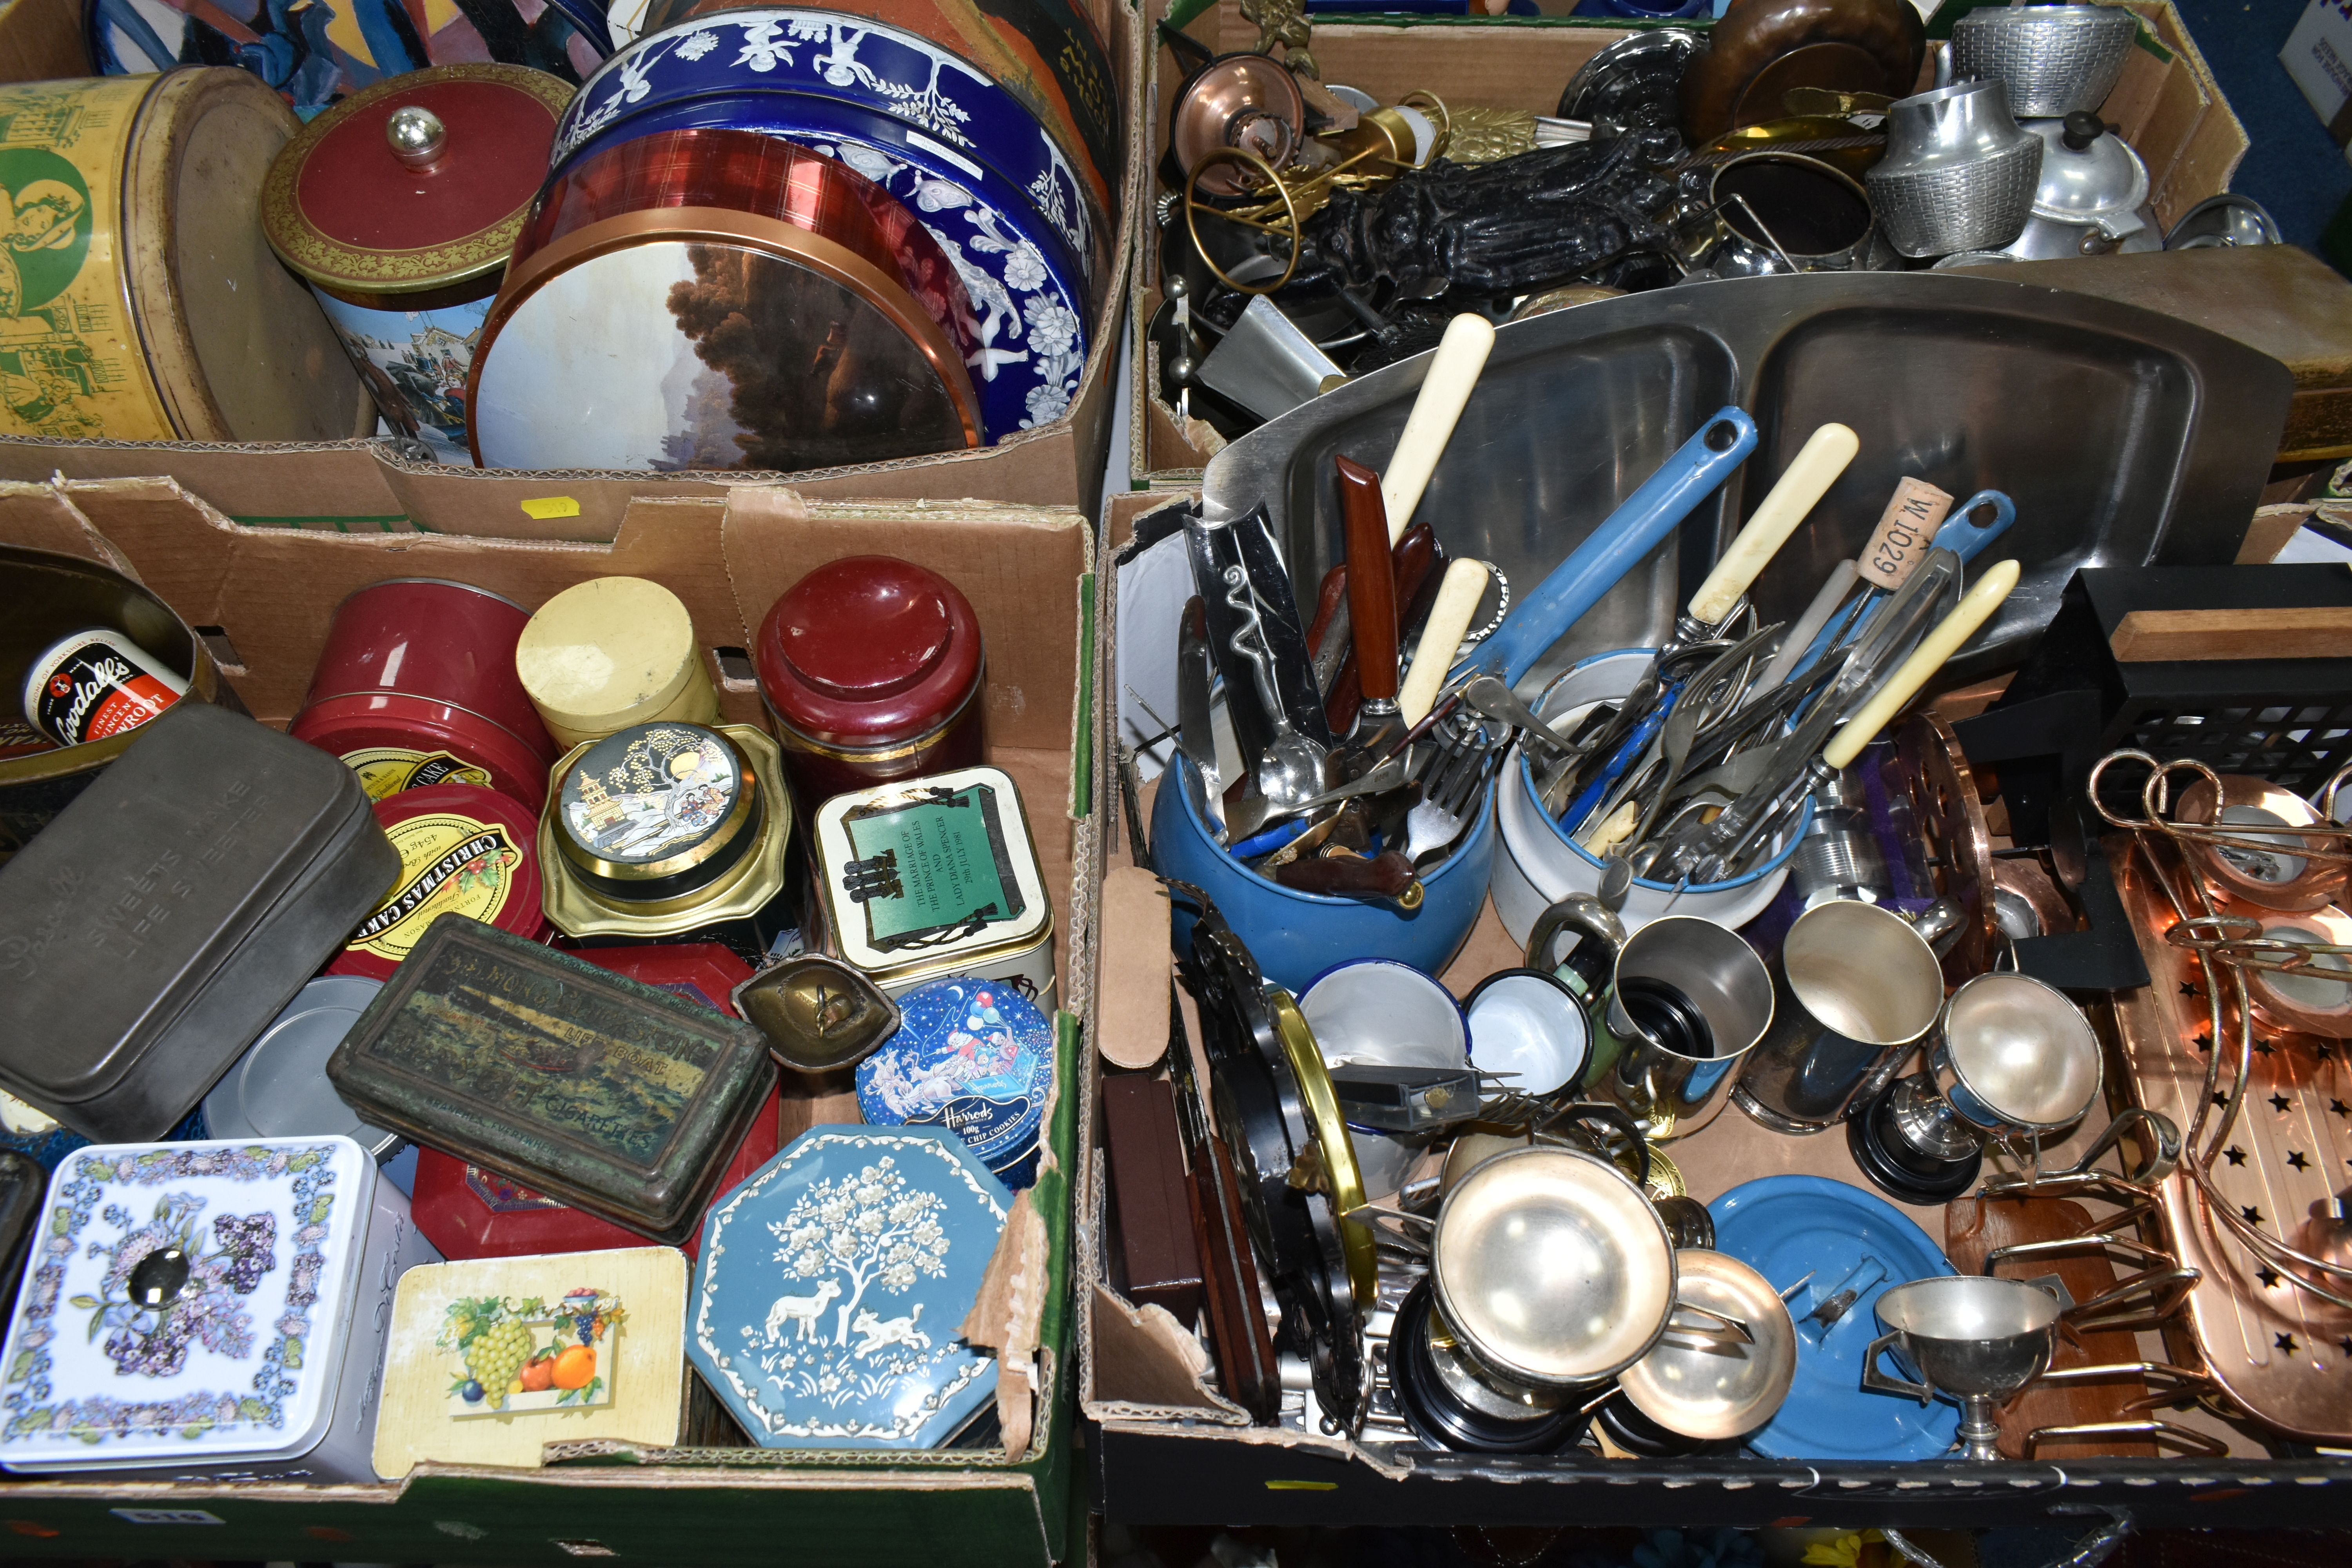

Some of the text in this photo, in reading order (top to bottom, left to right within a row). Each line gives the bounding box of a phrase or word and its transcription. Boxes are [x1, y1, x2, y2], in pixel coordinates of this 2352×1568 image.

[1873, 519, 1918, 574] 1029
[33, 682, 43, 704] HOME
[42, 669, 51, 679] OF
[50, 641, 88, 668] YORKSHIRE
[90, 638, 117, 646] RELISH
[94, 702, 117, 735] FINEST
[416, 762, 450, 785] CAKE
[410, 834, 438, 851] 454g
[423, 846, 441, 861] with
[953, 831, 973, 884] 29th JULY 1981
[402, 835, 497, 910] CHRISTMAS
[901, 831, 926, 907] THE MARRIAGE OF
[912, 820, 940, 912] THE PRINCE OF WALES
[933, 854, 944, 873] AND
[935, 816, 965, 906] LADY DIANA SPENCER
[417, 890, 460, 920] Traditional
[613, 1045, 669, 1075] BOAT
[967, 1077, 1007, 1094] Harrods
[940, 1102, 993, 1129] Harrods
[963, 1125, 980, 1135] 100g
[967, 1111, 1021, 1143] CHIP COOKIES
